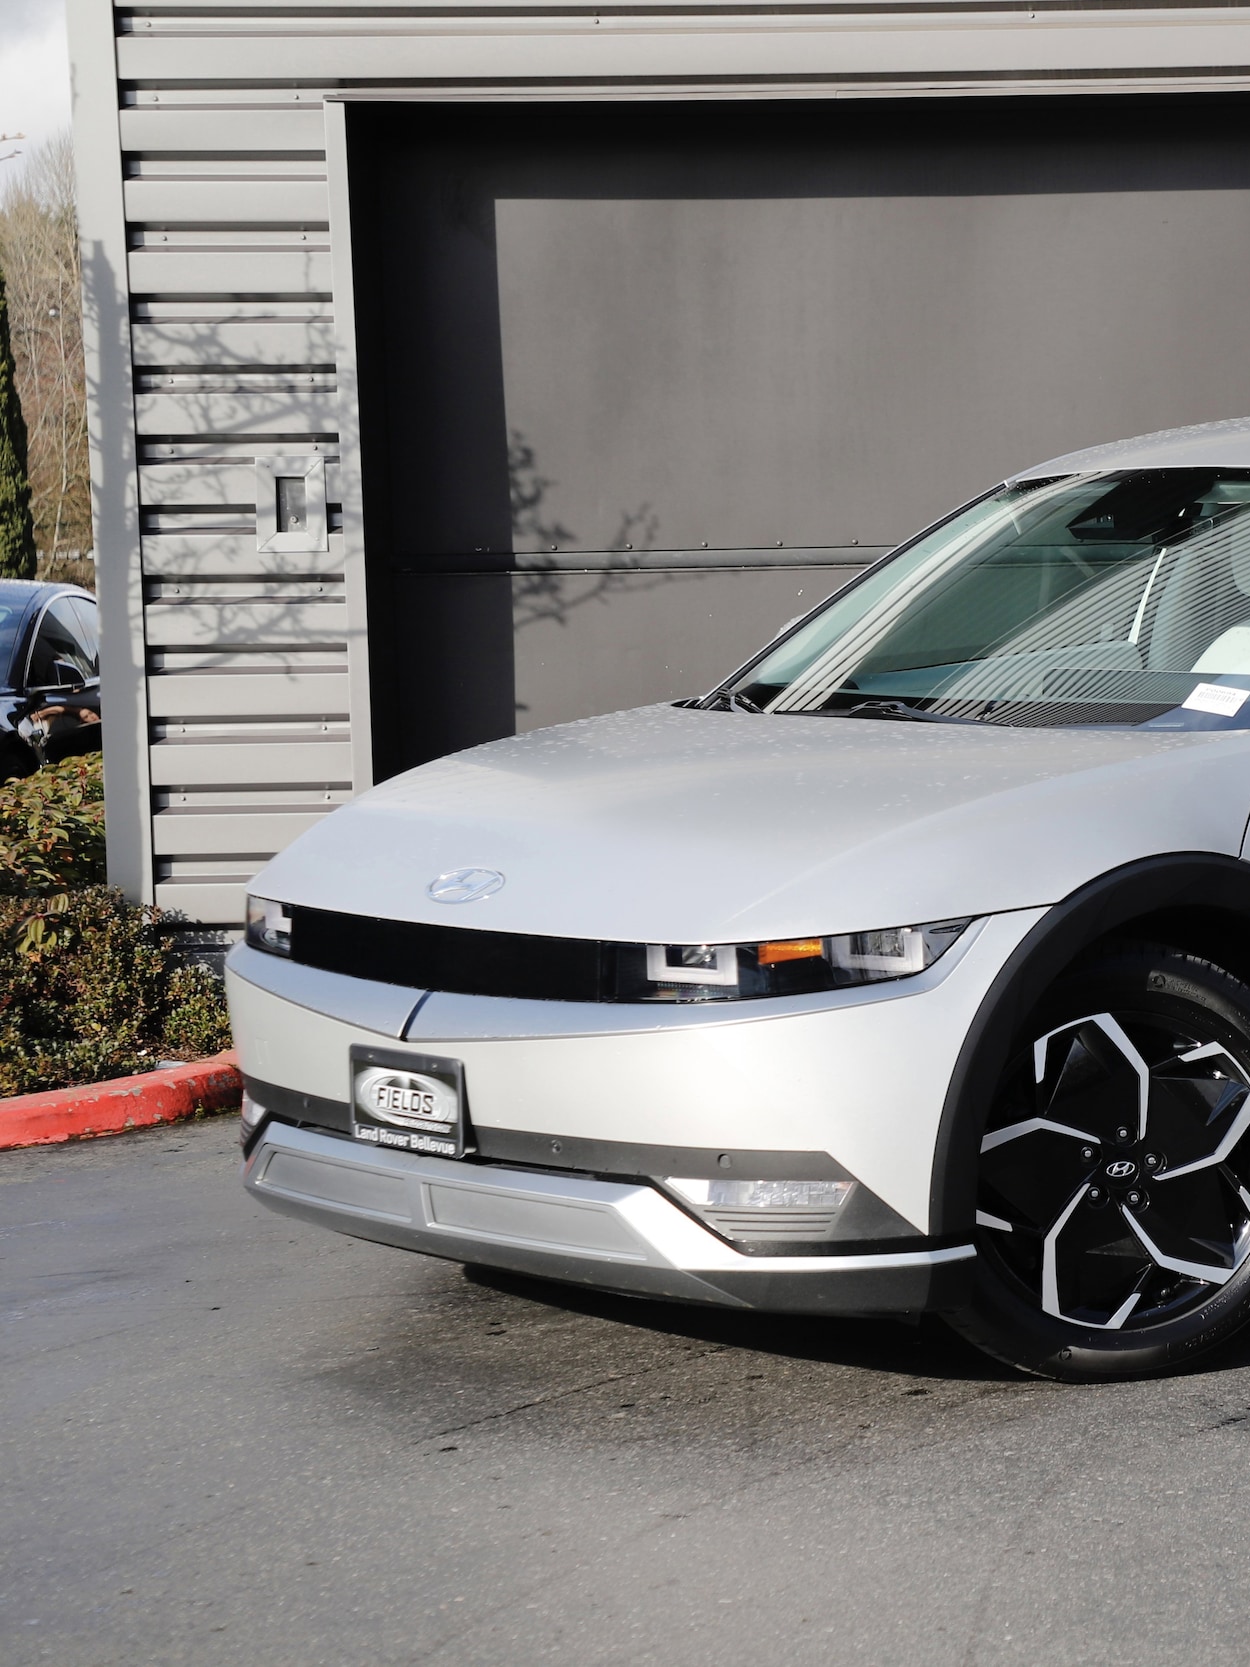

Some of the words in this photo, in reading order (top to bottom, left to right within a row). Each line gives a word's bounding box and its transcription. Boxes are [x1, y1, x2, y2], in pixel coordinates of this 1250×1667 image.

[376, 1087, 434, 1115] FIELDS
[355, 1124, 379, 1142] Land
[379, 1129, 409, 1147] Rover
[410, 1134, 456, 1155] Bellevue
